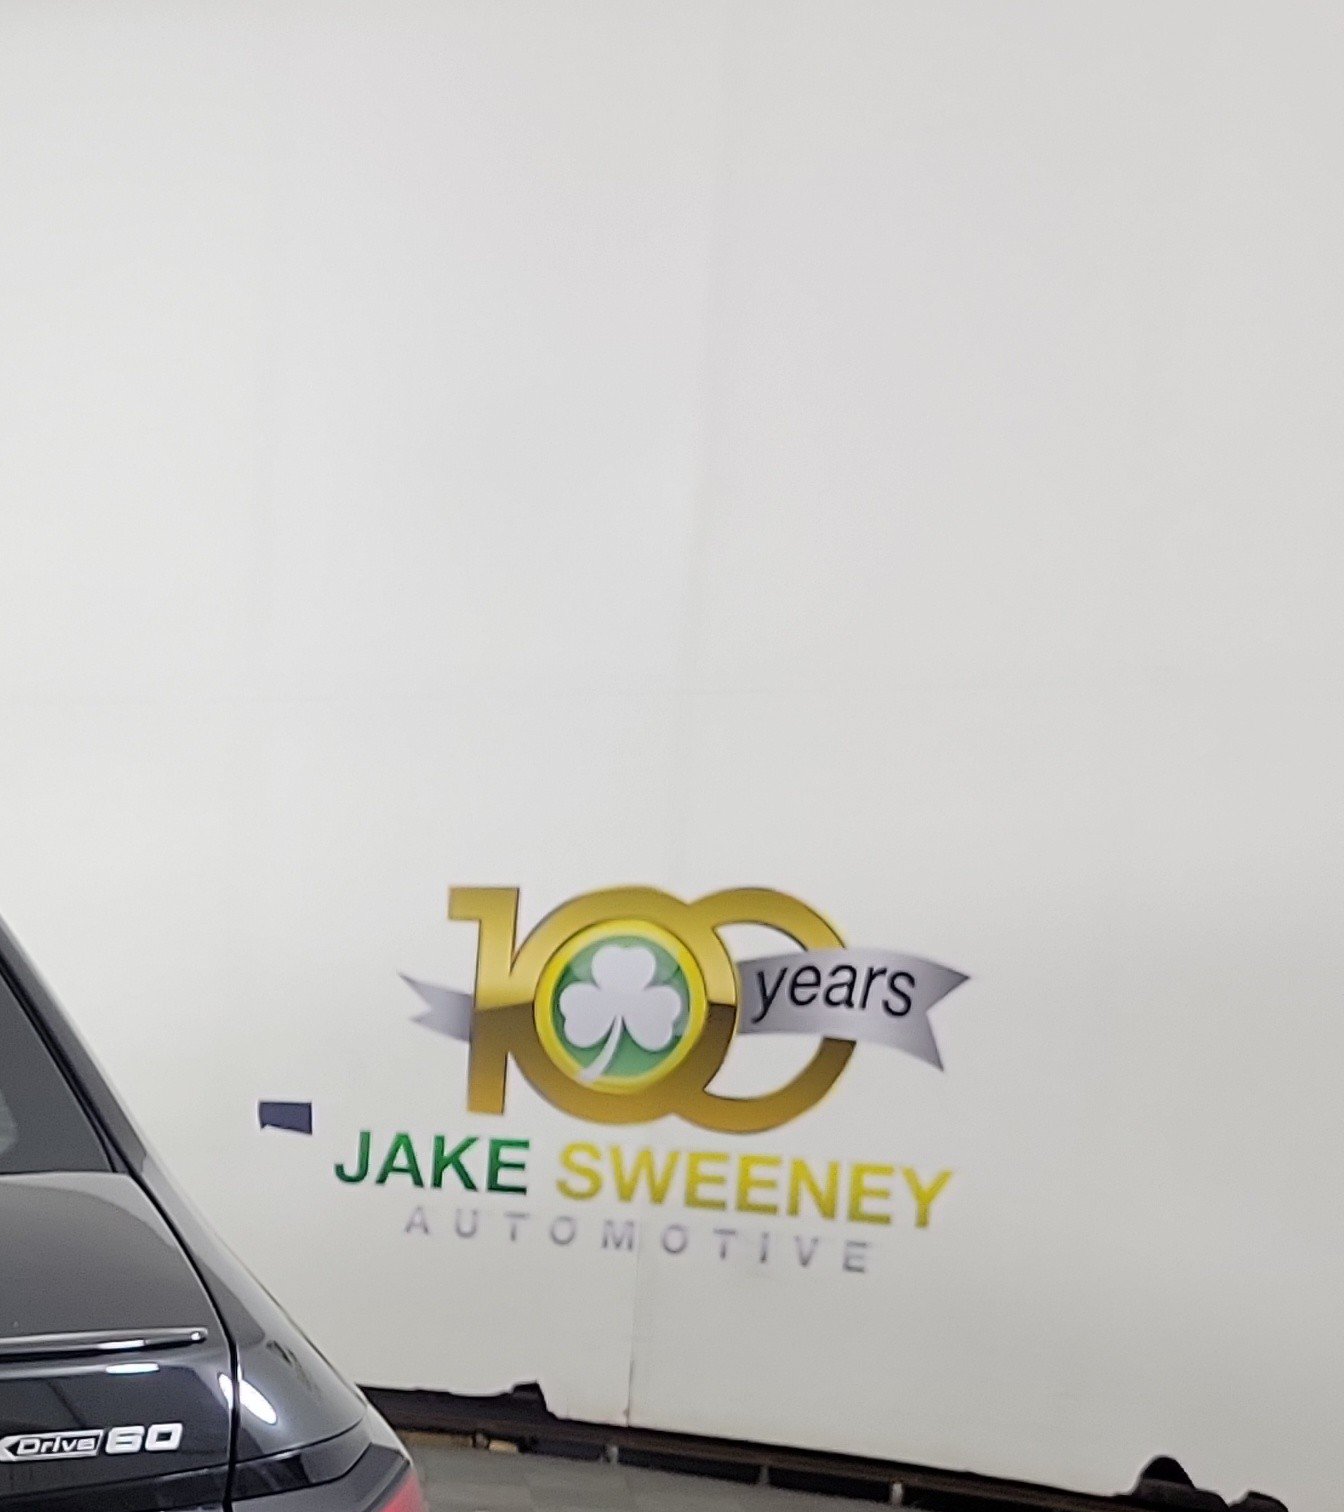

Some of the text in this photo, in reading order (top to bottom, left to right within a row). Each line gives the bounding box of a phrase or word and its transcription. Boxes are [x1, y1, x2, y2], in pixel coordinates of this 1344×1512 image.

[749, 958, 917, 1024] years
[333, 1129, 954, 1228] JAKE SWEENEY
[404, 1204, 869, 1273] AUTOMOTIVE
